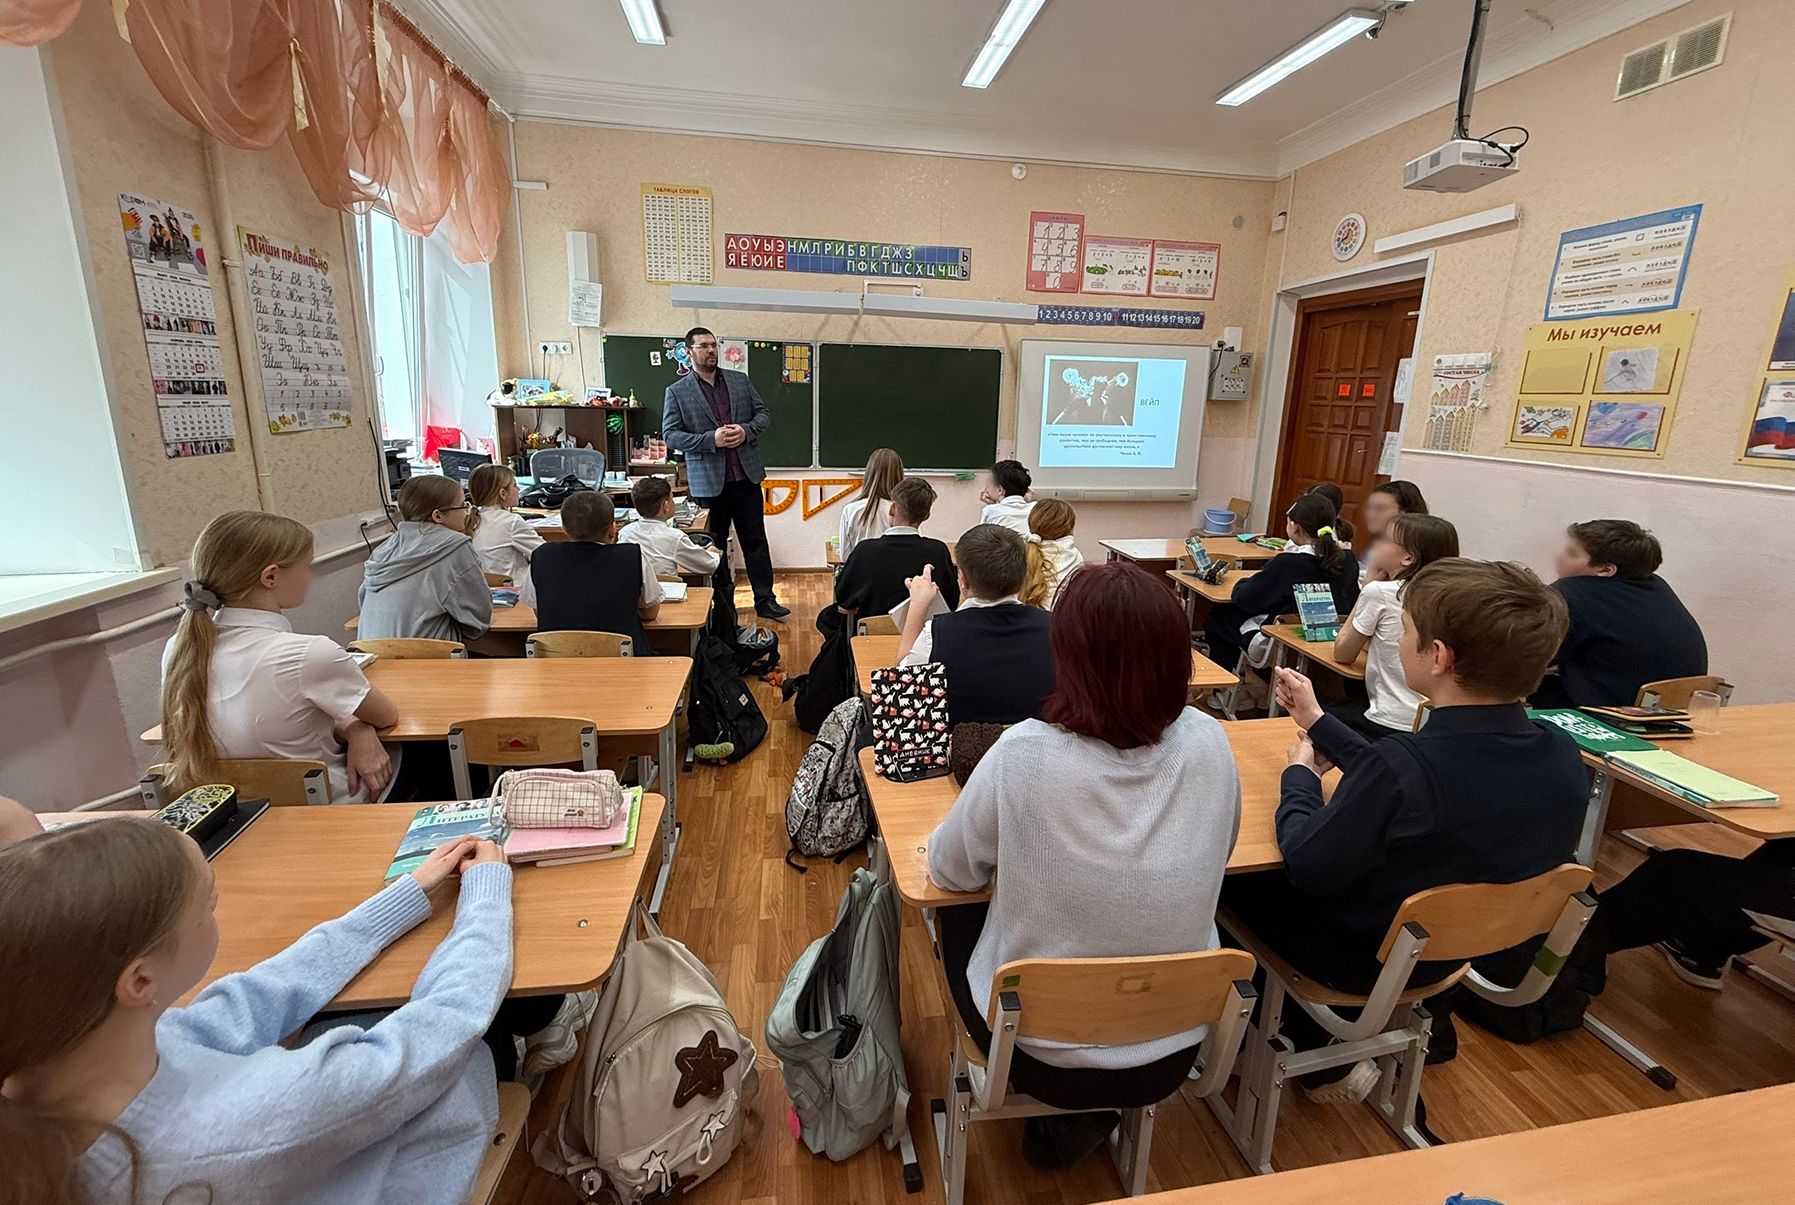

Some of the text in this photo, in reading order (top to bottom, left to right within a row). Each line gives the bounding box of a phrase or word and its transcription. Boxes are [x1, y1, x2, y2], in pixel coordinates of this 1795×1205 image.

[1043, 226, 1079, 240] 1 2 3
[1042, 242, 1048, 256] 4
[1056, 244, 1063, 256] 5
[1070, 245, 1078, 257] 6
[1041, 259, 1076, 273] 7 8 9
[1053, 276, 1061, 288] 0
[1039, 310, 1043, 318] 1
[1046, 310, 1050, 318] 2
[1053, 310, 1058, 319] 3
[1067, 311, 1072, 319] 5
[1074, 311, 1079, 320] 6
[1089, 312, 1094, 320] 8
[1096, 312, 1100, 320] 9
[1103, 312, 1112, 321] 10
[1547, 322, 1662, 342] Мы изучаем
